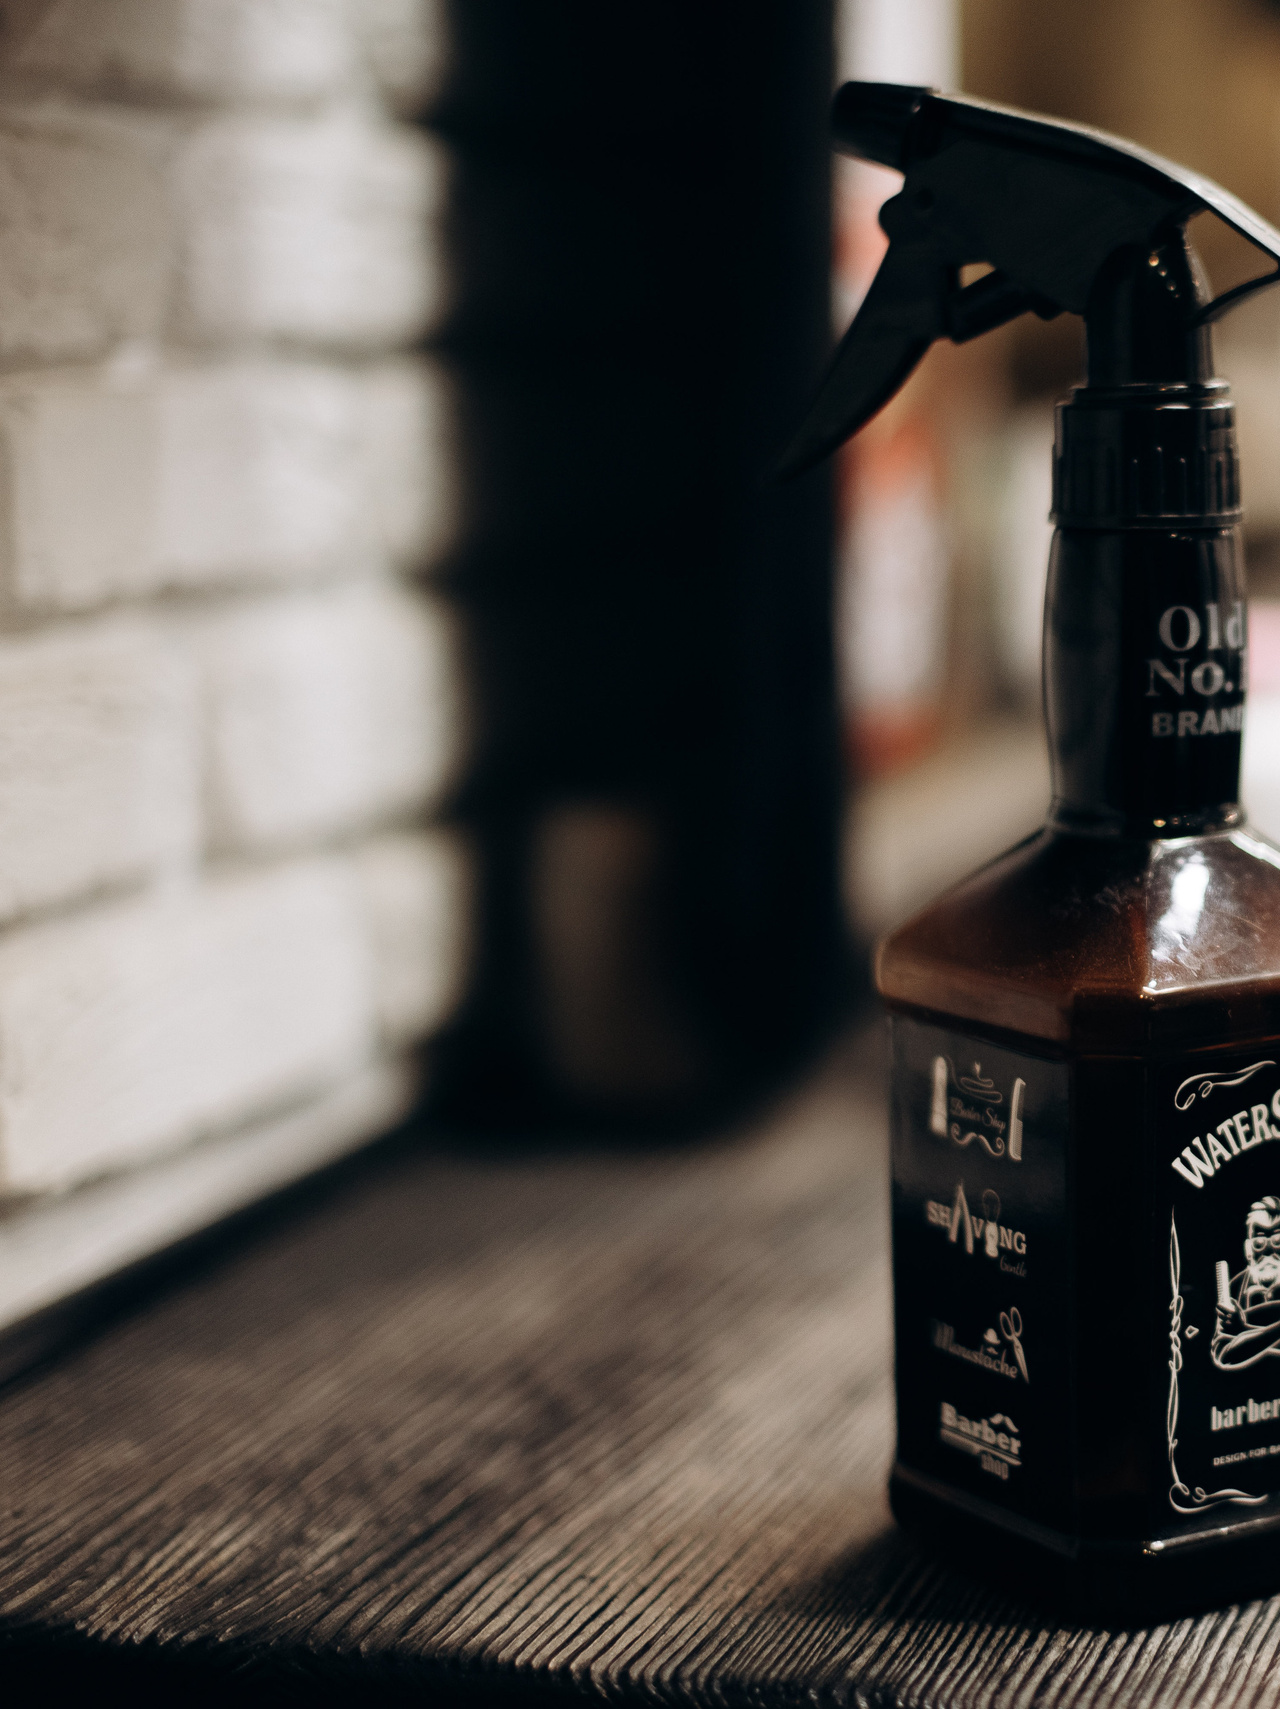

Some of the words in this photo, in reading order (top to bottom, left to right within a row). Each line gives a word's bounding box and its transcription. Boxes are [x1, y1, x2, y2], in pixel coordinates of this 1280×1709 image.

[1158, 601, 1246, 652] Old
[1151, 703, 1243, 738] BRAN
[1212, 1451, 1247, 1467] DESIGN
[1248, 1446, 1267, 1459] FOR
